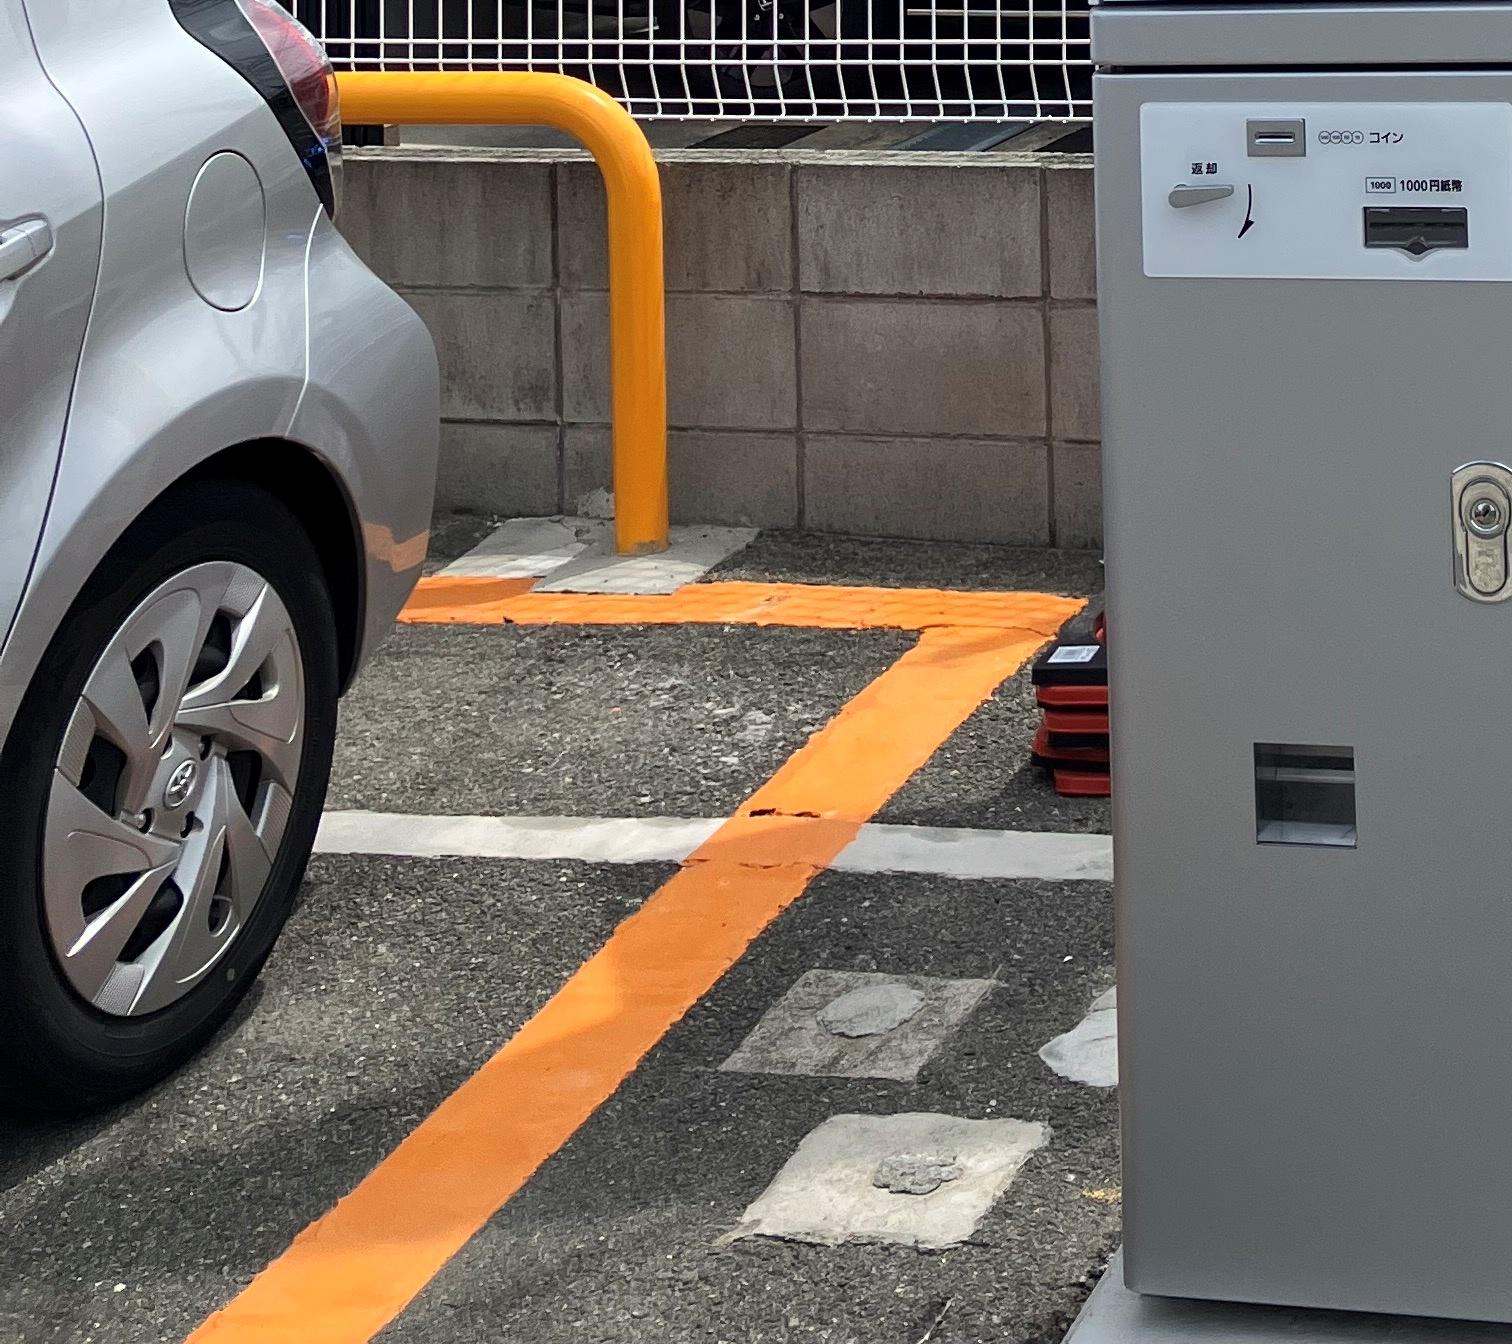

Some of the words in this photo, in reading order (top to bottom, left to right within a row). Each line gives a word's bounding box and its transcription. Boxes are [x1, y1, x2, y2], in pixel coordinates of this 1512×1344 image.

[1369, 132, 1404, 144] コイン
[1191, 162, 1218, 175] 返却
[1370, 181, 1392, 190] 1000
[1400, 179, 1463, 192] 1000円紙幣
